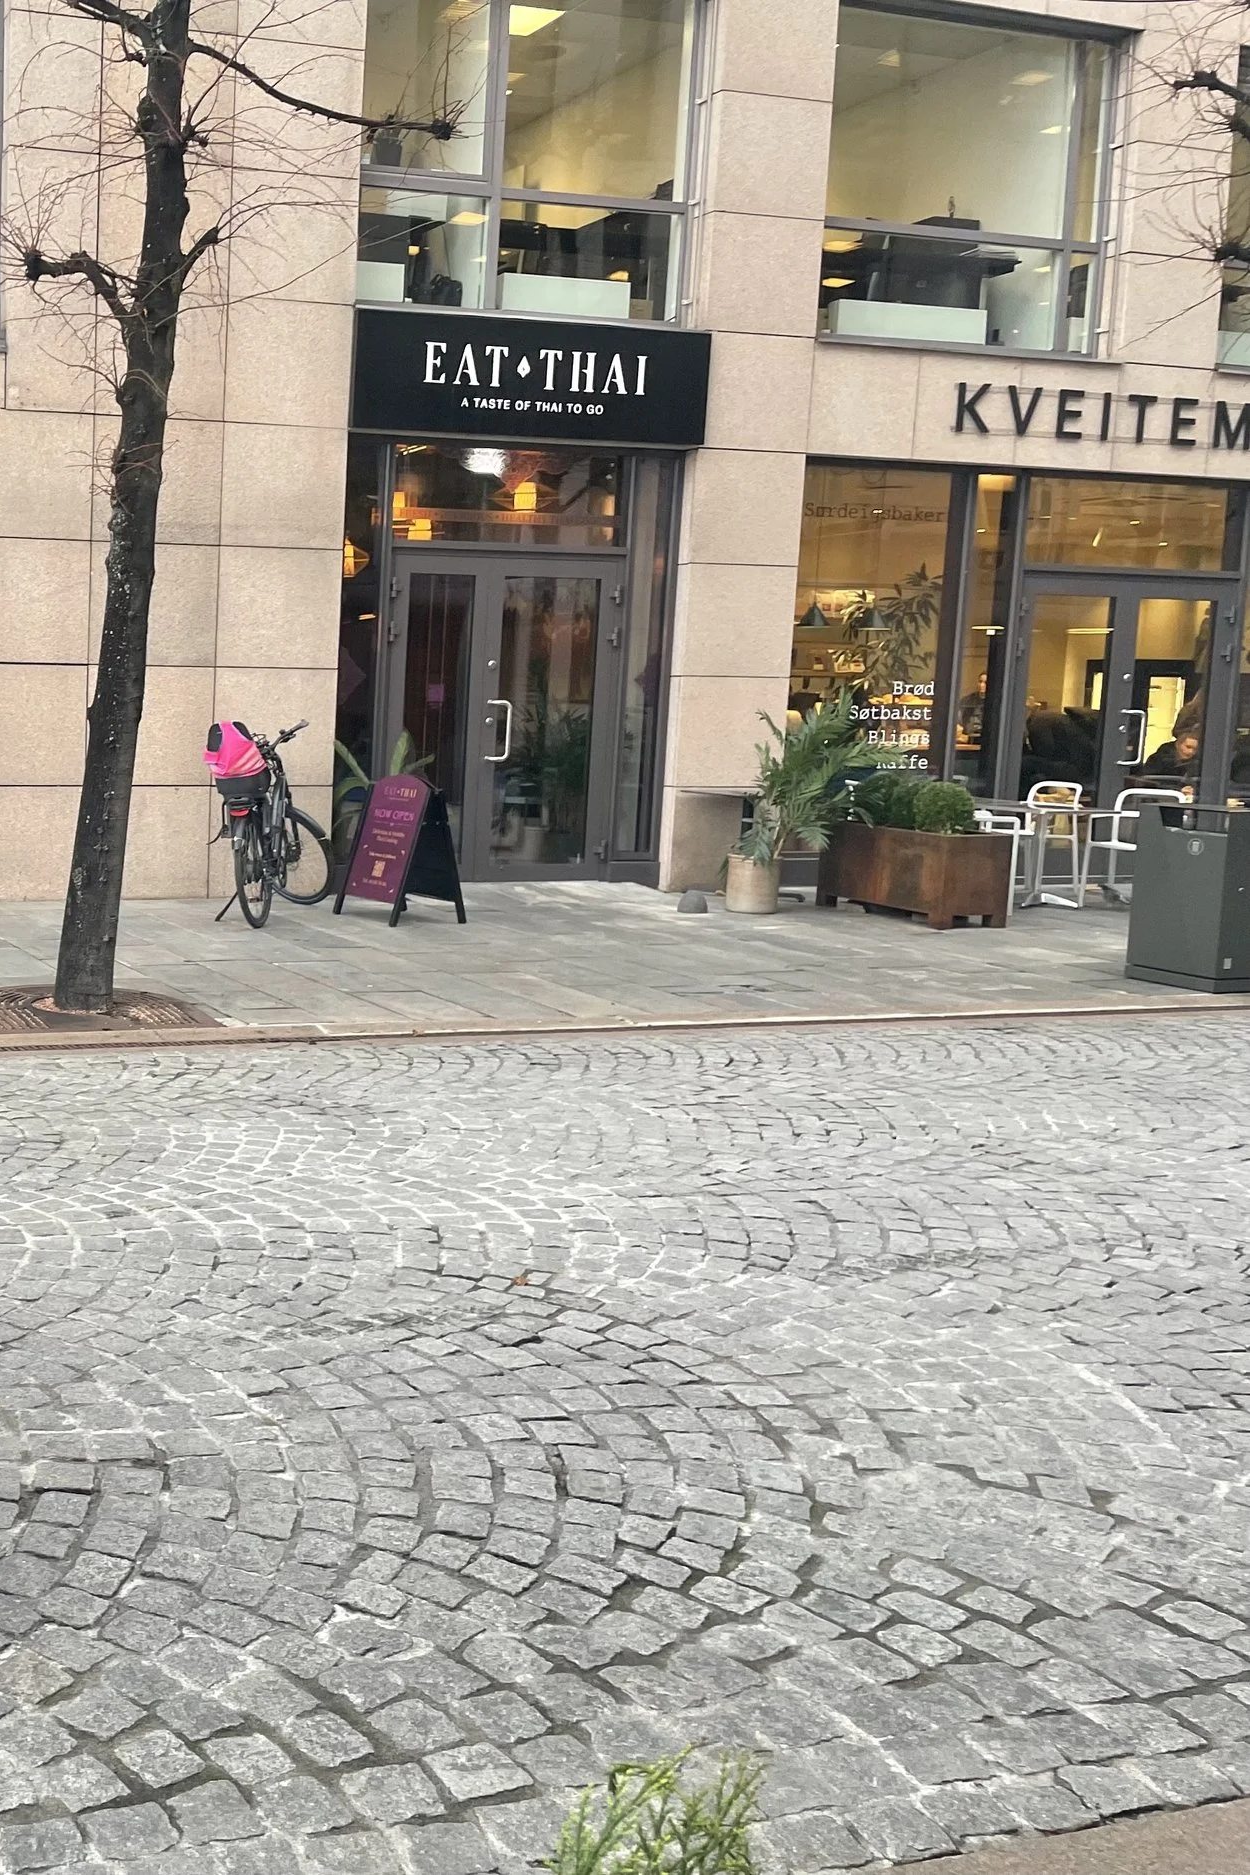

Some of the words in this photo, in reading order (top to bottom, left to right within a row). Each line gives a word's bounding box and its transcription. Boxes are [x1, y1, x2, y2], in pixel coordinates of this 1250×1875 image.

[423, 341, 509, 387] EAT
[540, 349, 648, 396] THAI
[460, 397, 469, 408] A
[473, 397, 511, 411] TASTE
[514, 399, 531, 411] OF
[535, 401, 562, 413] THAI
[566, 402, 583, 414] TO
[586, 404, 604, 415] GO
[954, 381, 1250, 451] KVEITEM
[892, 681, 935, 696] Brød
[849, 705, 933, 720] Søtbakst
[867, 730, 930, 747] Blings
